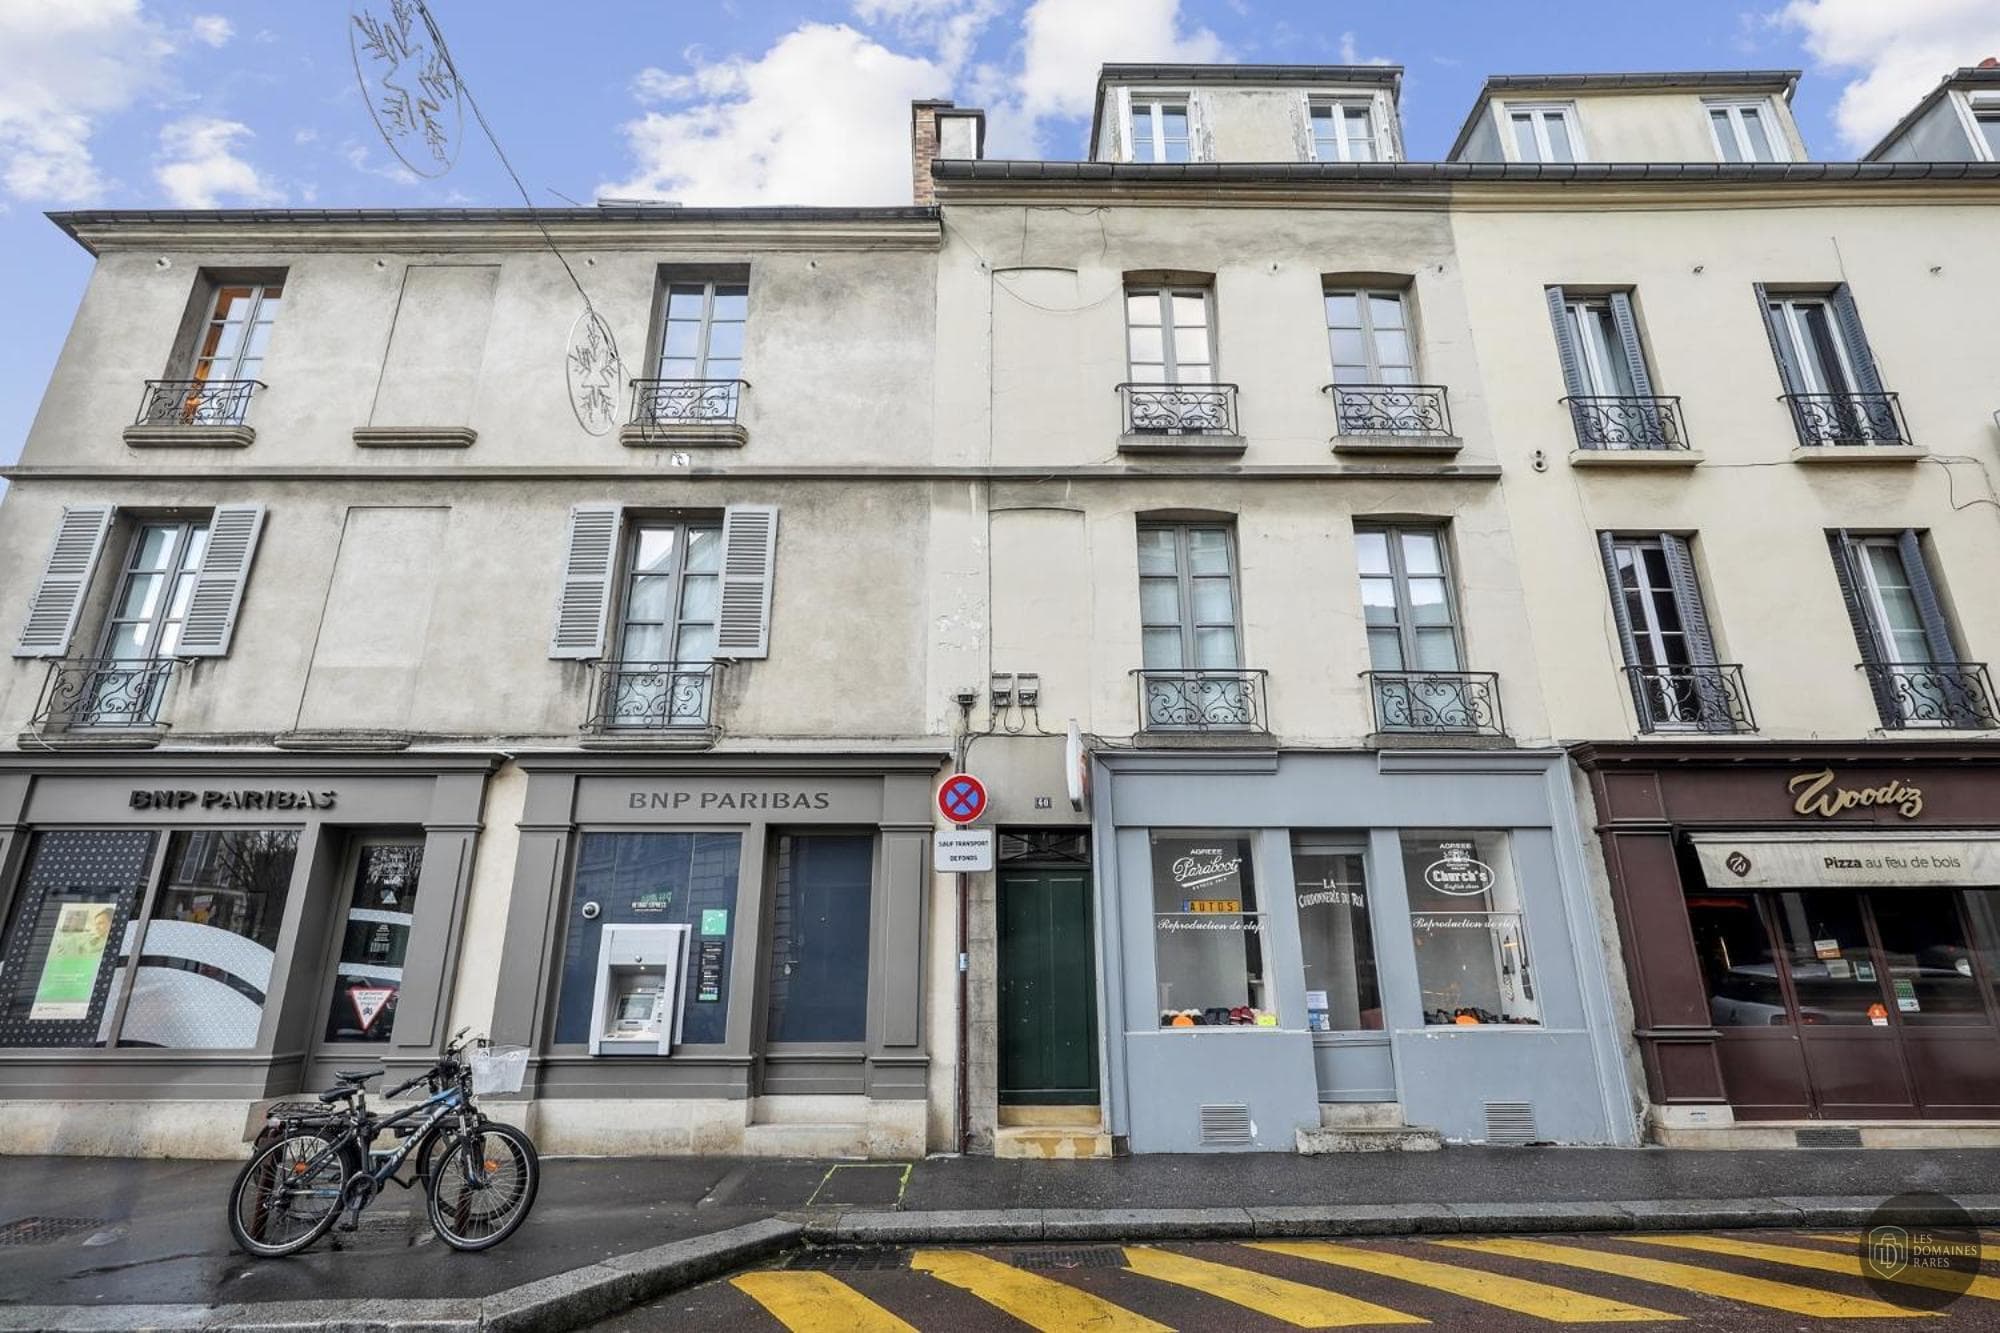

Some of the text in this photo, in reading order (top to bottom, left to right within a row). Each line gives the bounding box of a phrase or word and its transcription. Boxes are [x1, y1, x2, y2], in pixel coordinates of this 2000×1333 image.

[128, 790, 337, 810] BNP PARIBAS
[1788, 768, 1923, 818] Woodiz
[629, 792, 830, 810] BNP PARIBAS
[1172, 856, 1243, 882] Paraboot
[1824, 856, 1961, 869] Pizza au feu de bois
[1432, 869, 1489, 882] Church's
[1323, 879, 1336, 889] LA
[1190, 901, 1234, 912] AUTOS
[1158, 918, 1227, 933] Reproduction
[1229, 920, 1241, 930] de
[1413, 917, 1483, 931] Reproduction
